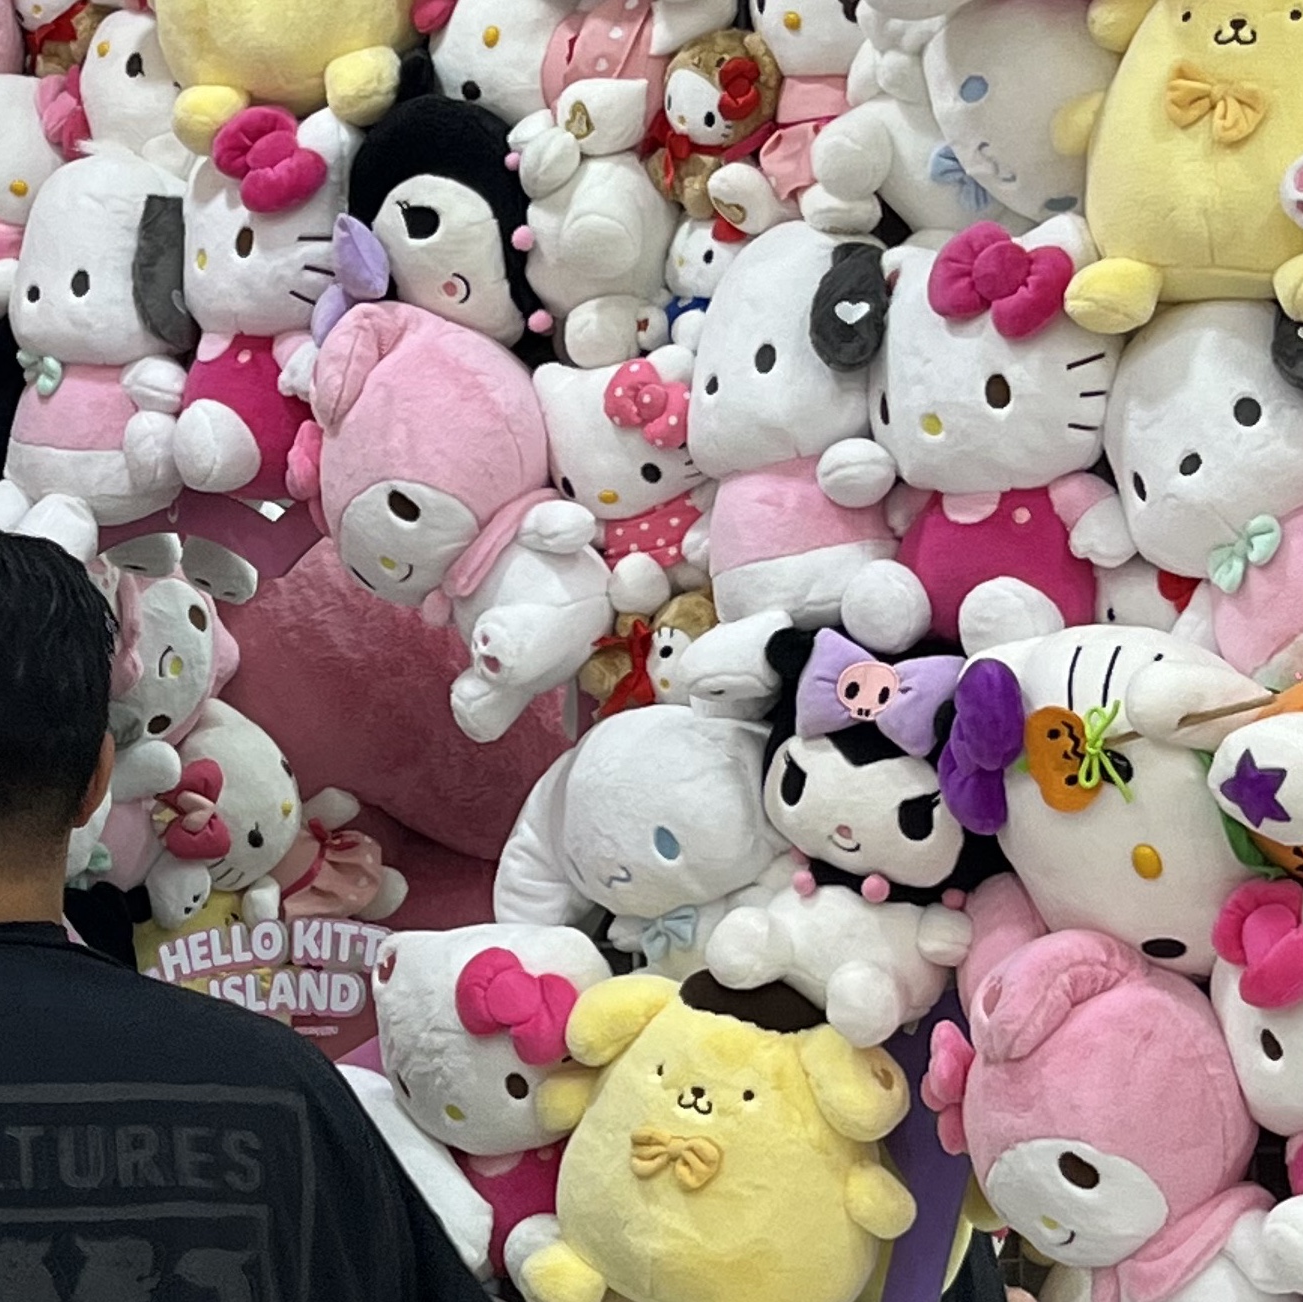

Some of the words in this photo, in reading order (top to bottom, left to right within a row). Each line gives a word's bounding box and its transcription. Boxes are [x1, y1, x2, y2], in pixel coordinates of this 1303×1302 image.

[159, 920, 282, 981] HELLO
[293, 919, 388, 967] KITT
[209, 972, 359, 1012] ISLAND
